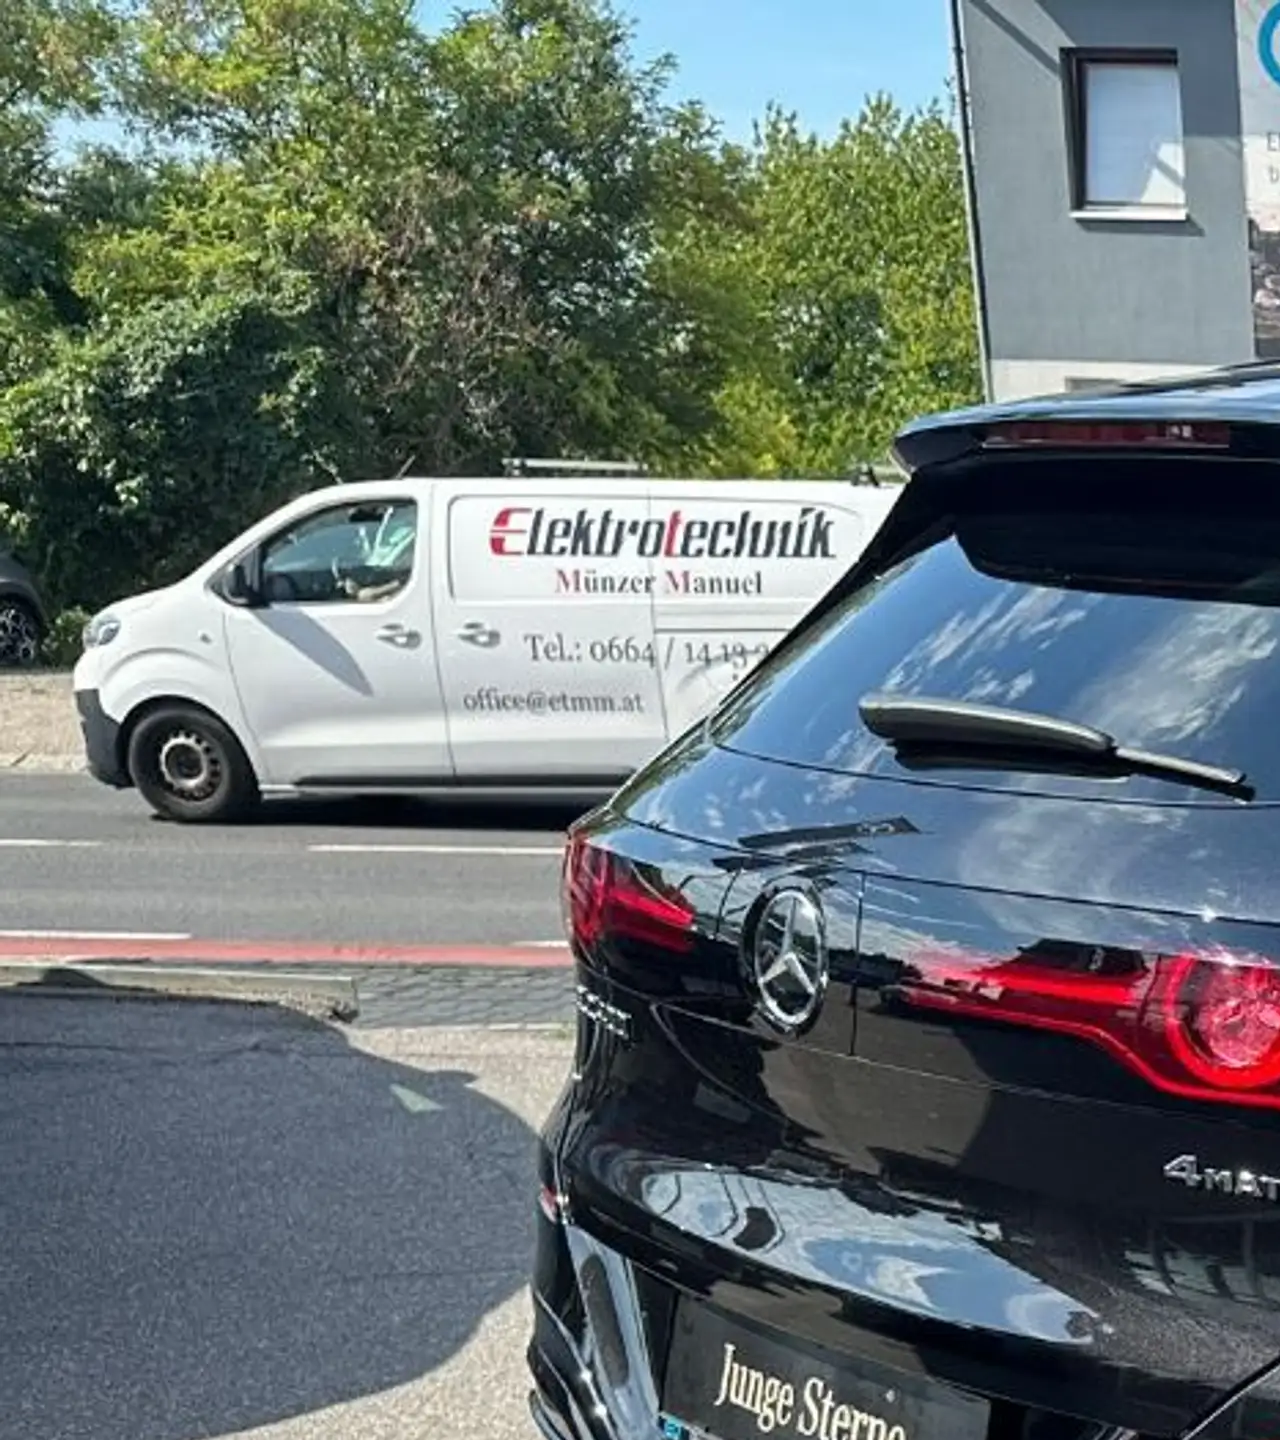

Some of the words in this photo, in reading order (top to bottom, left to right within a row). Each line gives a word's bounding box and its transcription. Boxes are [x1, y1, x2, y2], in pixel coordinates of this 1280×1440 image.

[489, 507, 836, 558] Elektrotechnik
[555, 568, 654, 594] Münzer
[665, 570, 762, 595] Manuel
[524, 634, 581, 663] Tel.:
[589, 635, 656, 669] 0664
[463, 689, 644, 714] office@etmm.at
[713, 1342, 794, 1433] Junge
